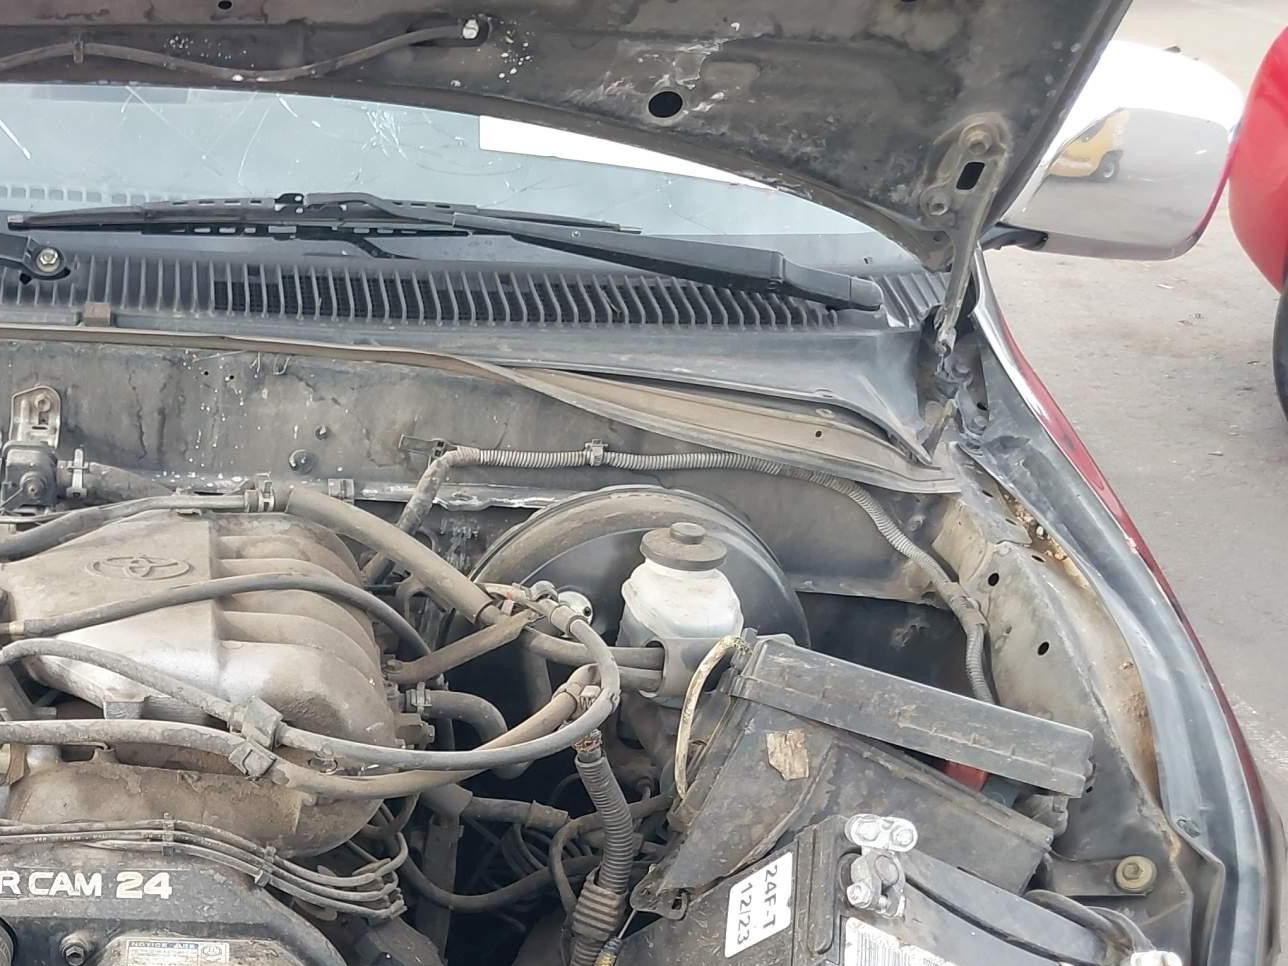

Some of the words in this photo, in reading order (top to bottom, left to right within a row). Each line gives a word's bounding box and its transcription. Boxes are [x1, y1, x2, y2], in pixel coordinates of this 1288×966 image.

[27, 871, 103, 897] CAM
[115, 872, 173, 900] 24
[736, 881, 754, 945] 12/23
[757, 864, 779, 929] 24F-T
